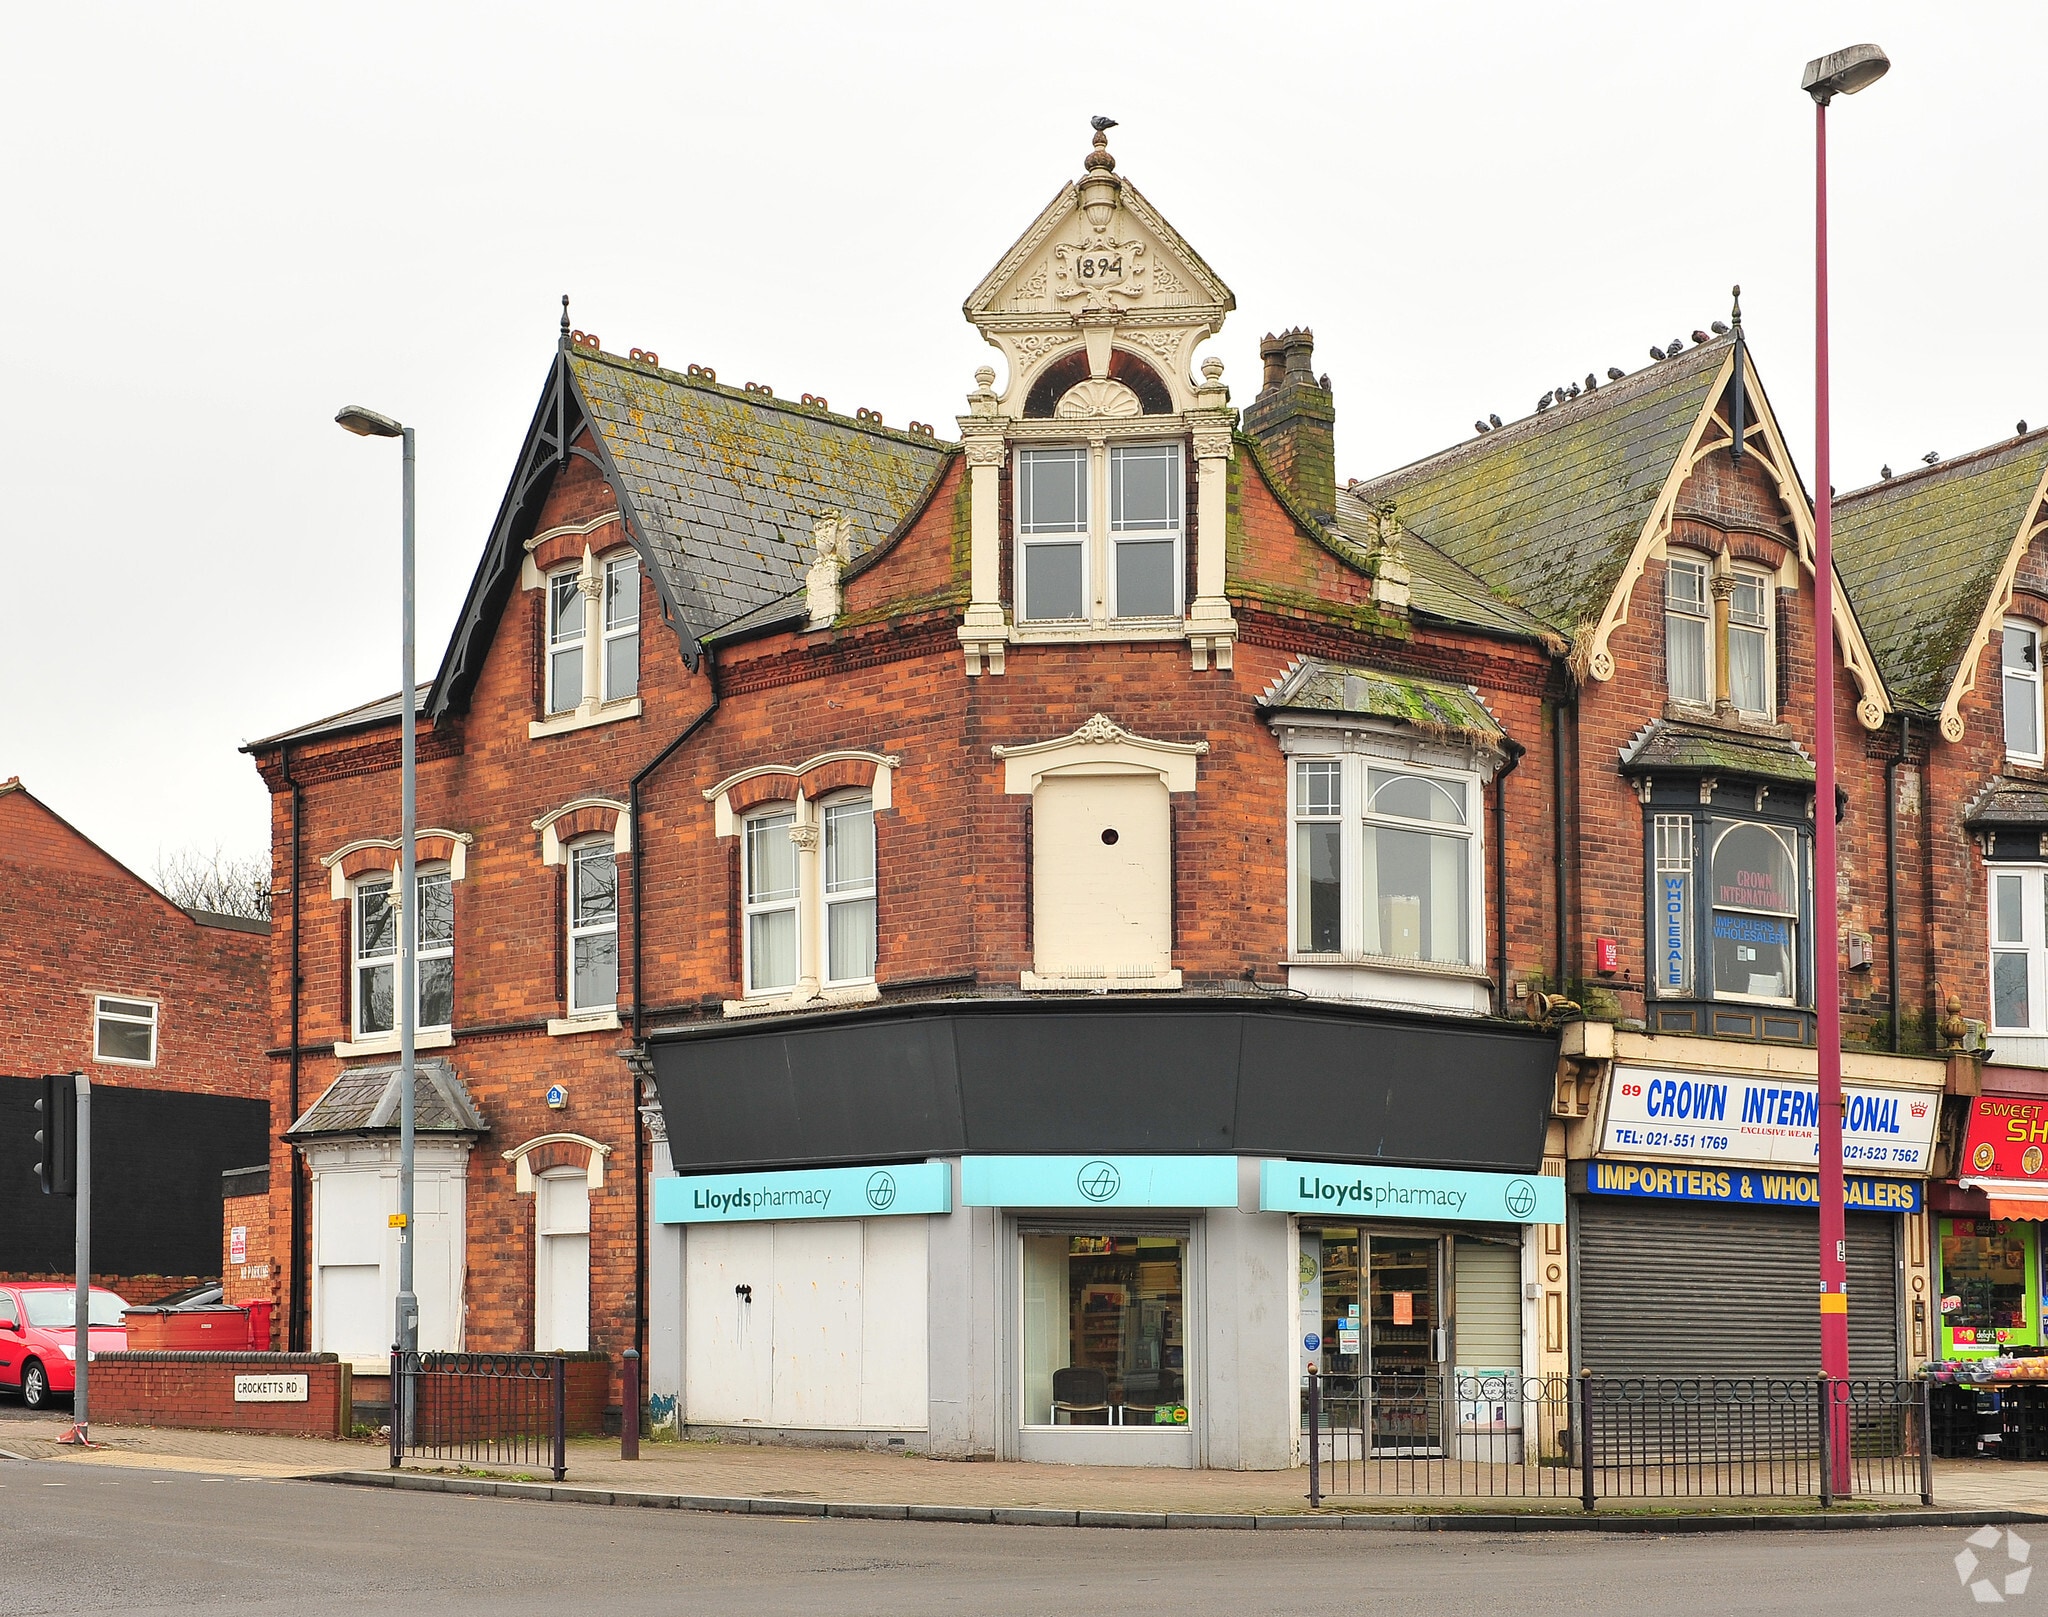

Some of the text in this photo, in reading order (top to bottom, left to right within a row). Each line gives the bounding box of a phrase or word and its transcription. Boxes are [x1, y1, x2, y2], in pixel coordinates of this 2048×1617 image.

[1077, 255, 1122, 278] 1894
[1737, 870, 1773, 889] CROWN
[1664, 879, 1683, 985] WHOLESALE
[1715, 916, 1774, 932] IMPORTERS
[1713, 926, 1789, 946] WHOLESALERS
[1621, 1079, 1900, 1134] 89 CROWN INTERNIONAL
[1980, 1102, 2042, 1118] SWEET
[1616, 1129, 1728, 1150] TEL: 021-551 1769
[1740, 1126, 1812, 1139] EXCLUSIVE WEAR
[1843, 1145, 1919, 1163] 021-523 7562
[1300, 1177, 1467, 1213] Lloydspharmacy
[1597, 1164, 1914, 1209] IMPORTERS & WHOLSALERS
[694, 1186, 831, 1214] Lloydspharmacy
[237, 1382, 284, 1394] CROCKETTS
[286, 1382, 298, 1393] RD
